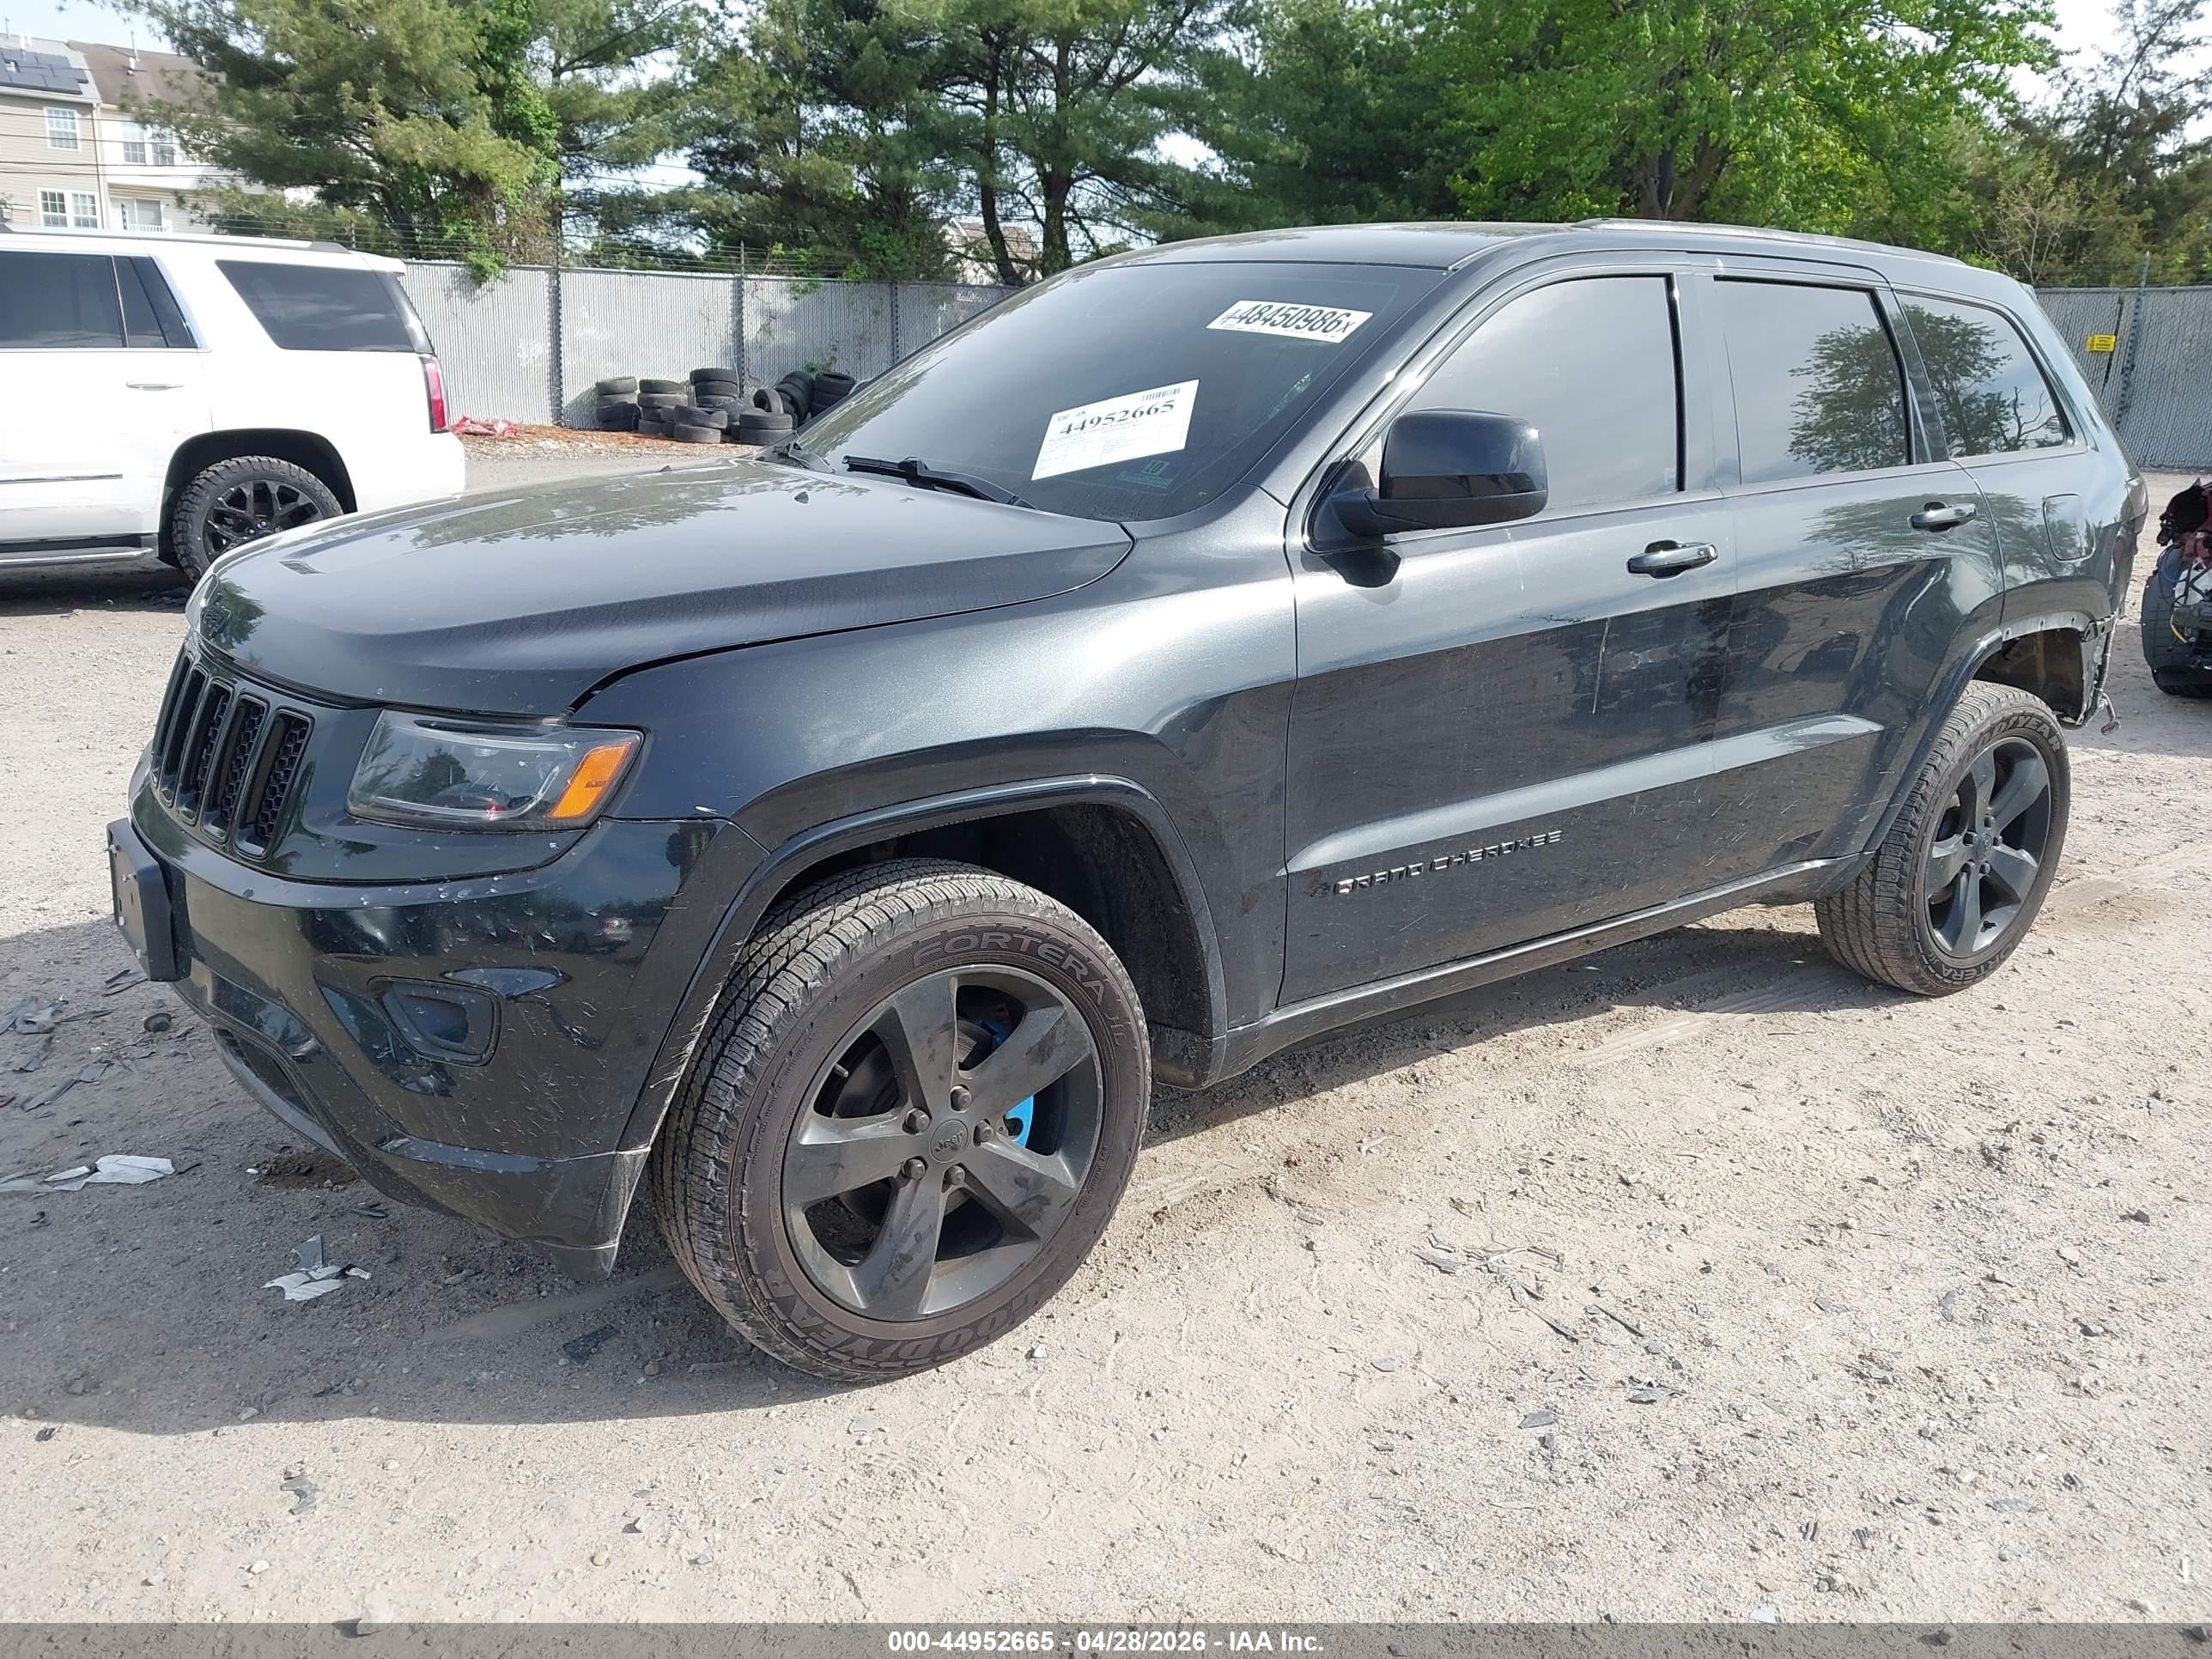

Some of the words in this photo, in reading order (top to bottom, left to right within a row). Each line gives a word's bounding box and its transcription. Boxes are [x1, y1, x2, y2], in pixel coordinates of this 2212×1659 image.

[1059, 399, 1176, 434] 44952665
[1334, 862, 1424, 895] GRAND
[1430, 830, 1563, 872] CHEROKEE
[914, 932, 1105, 1006] FORTERA
[1942, 939, 2016, 981] ORTERA
